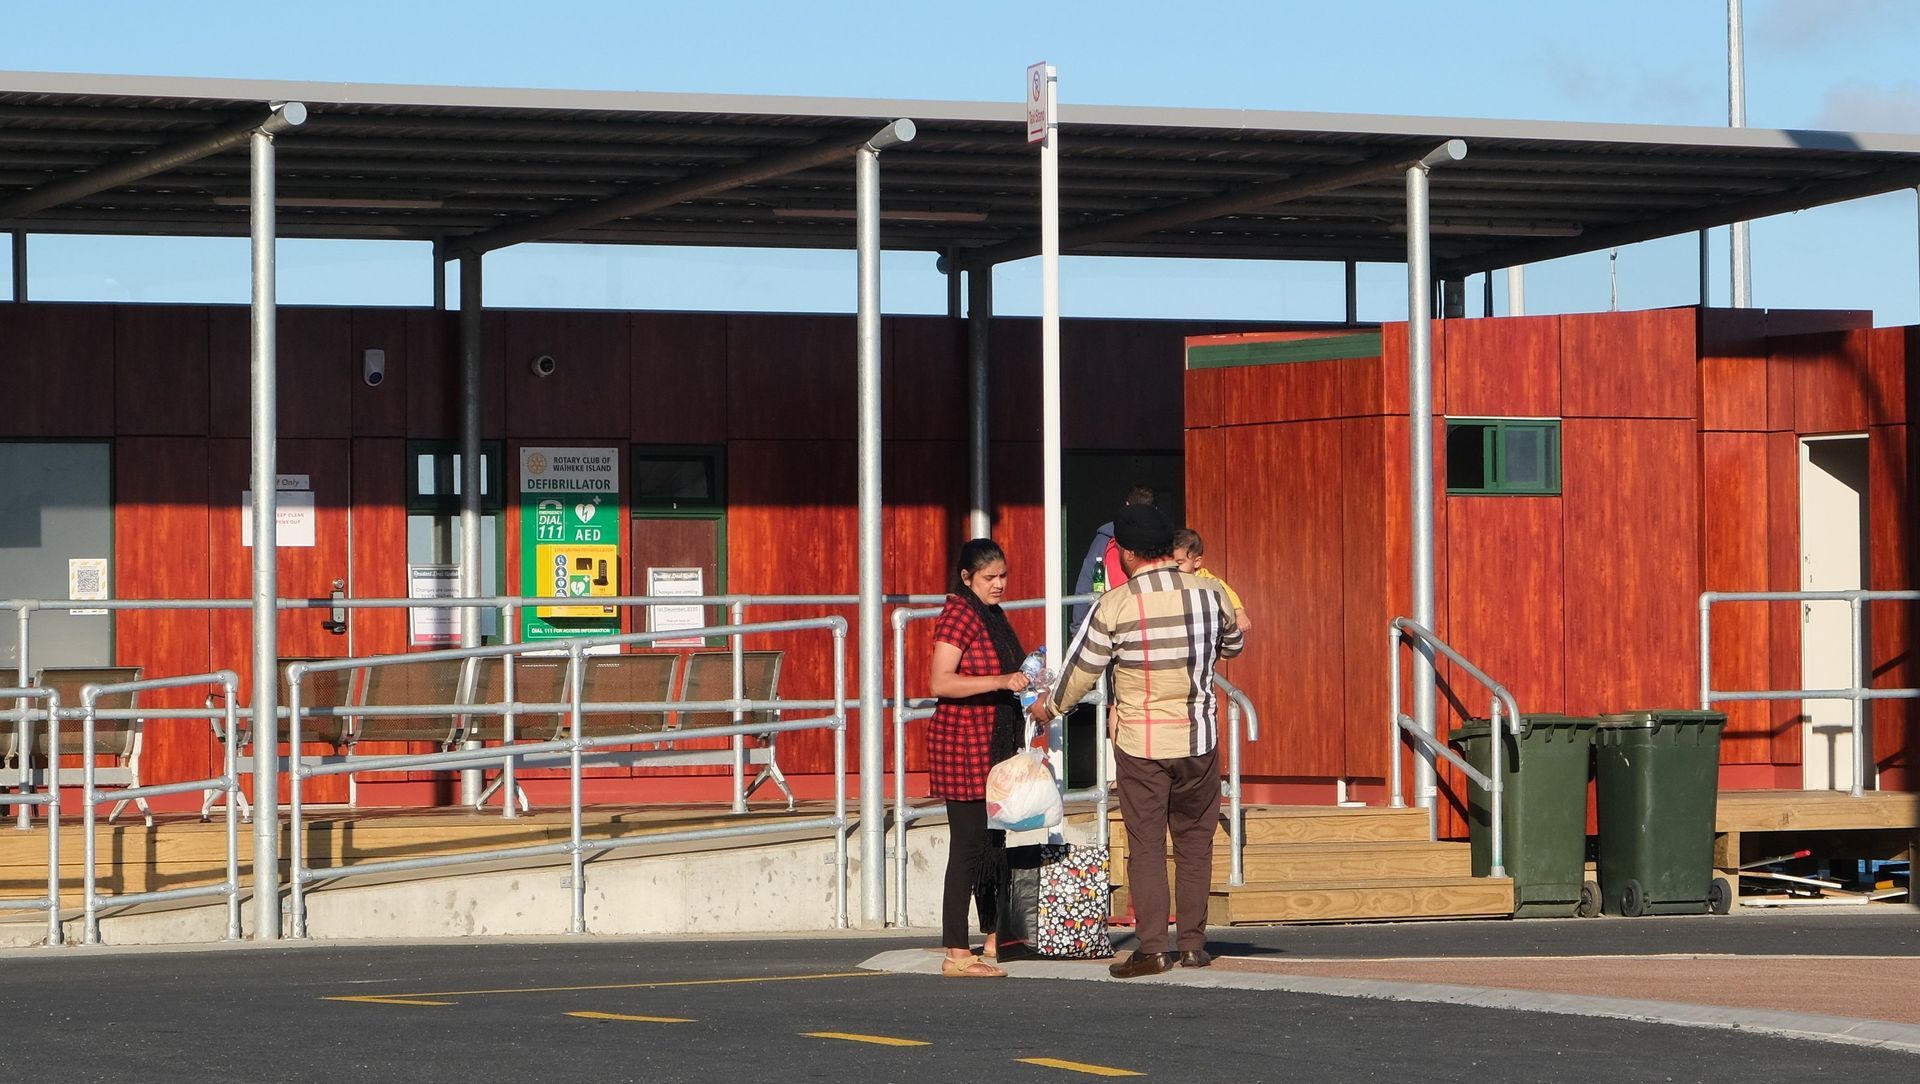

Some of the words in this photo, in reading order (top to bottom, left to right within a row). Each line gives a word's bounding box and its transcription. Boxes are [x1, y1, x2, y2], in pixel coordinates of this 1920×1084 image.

[553, 456, 580, 464] ROTARY
[582, 456, 599, 464] CLUB
[602, 456, 610, 464] OF
[552, 464, 584, 472] WAIHEKE
[586, 464, 611, 472] ISLAND
[282, 479, 299, 487] Only
[527, 478, 611, 490] DEFIBRILLATOR
[539, 515, 563, 525] DIAL
[539, 525, 563, 539] 111
[575, 529, 601, 541] AED
